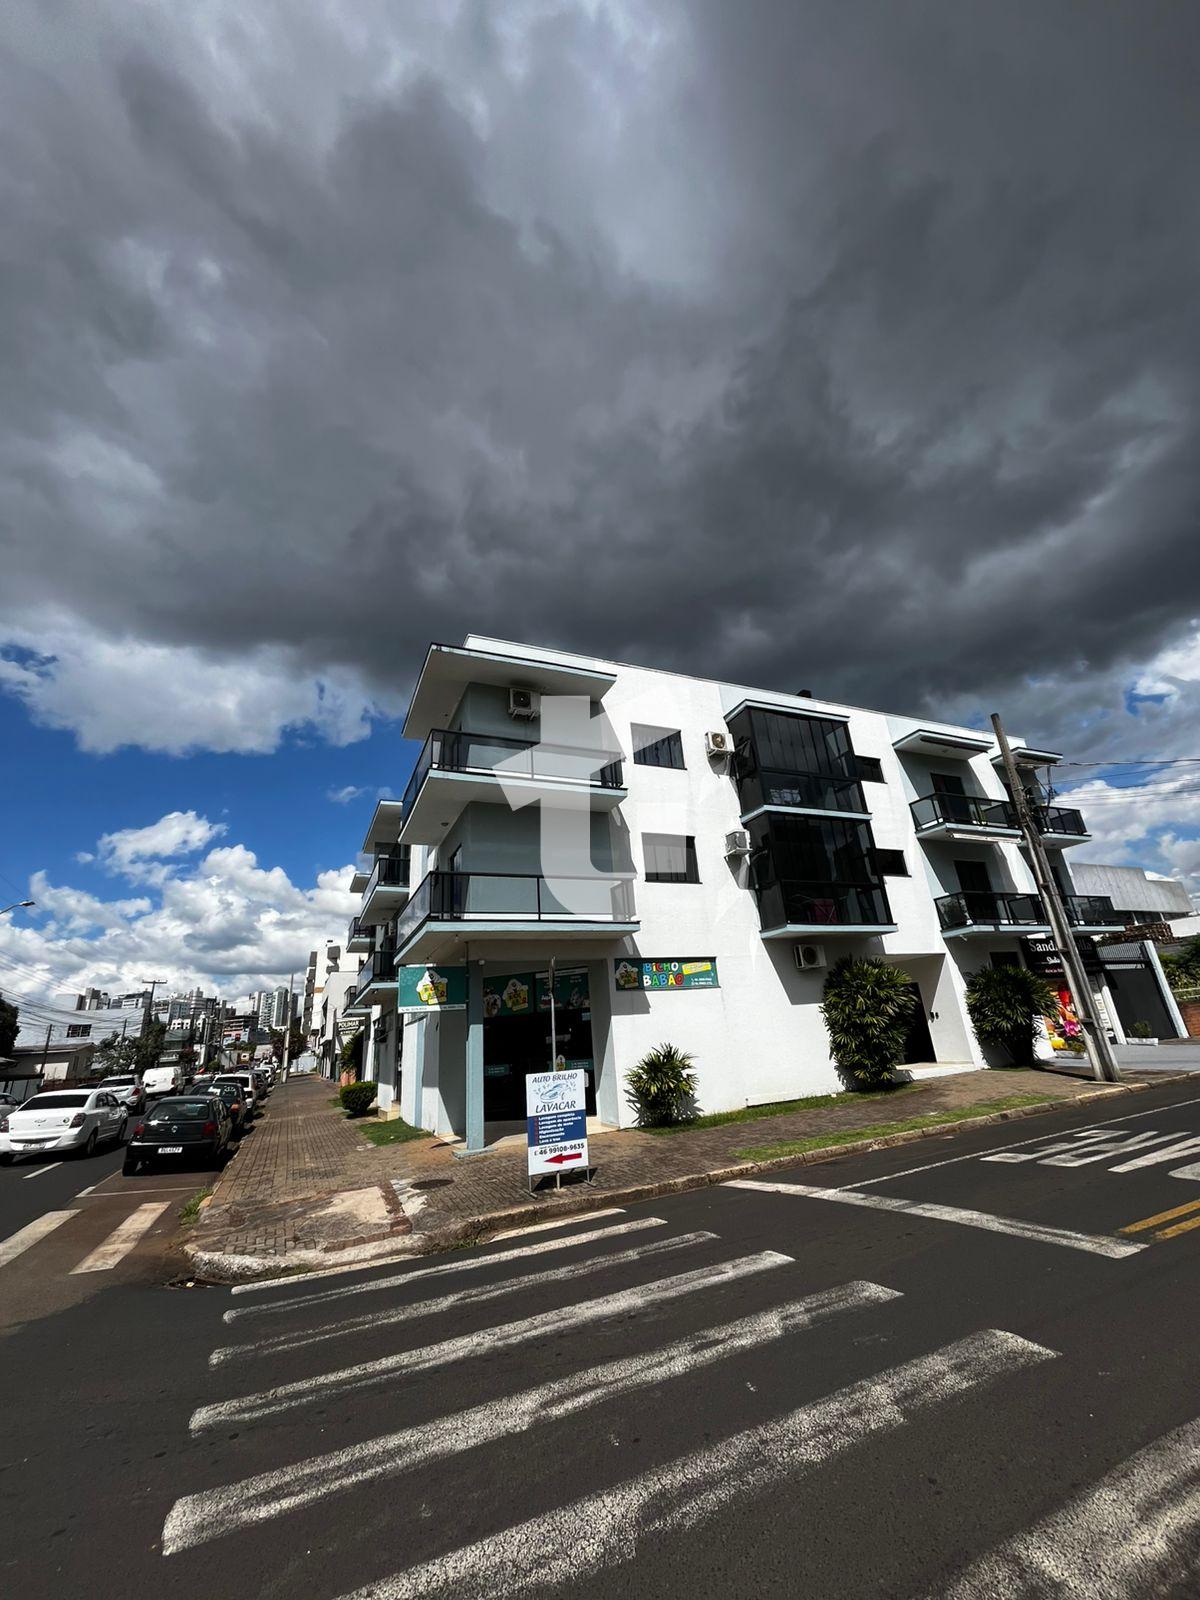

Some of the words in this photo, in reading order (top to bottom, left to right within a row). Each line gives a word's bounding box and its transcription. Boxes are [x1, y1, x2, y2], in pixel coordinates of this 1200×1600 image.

[643, 972, 684, 986] BABÃO
[532, 1076, 550, 1084] AUTO
[552, 1072, 578, 1082] BRILHO
[536, 1100, 576, 1113] LAVACAR
